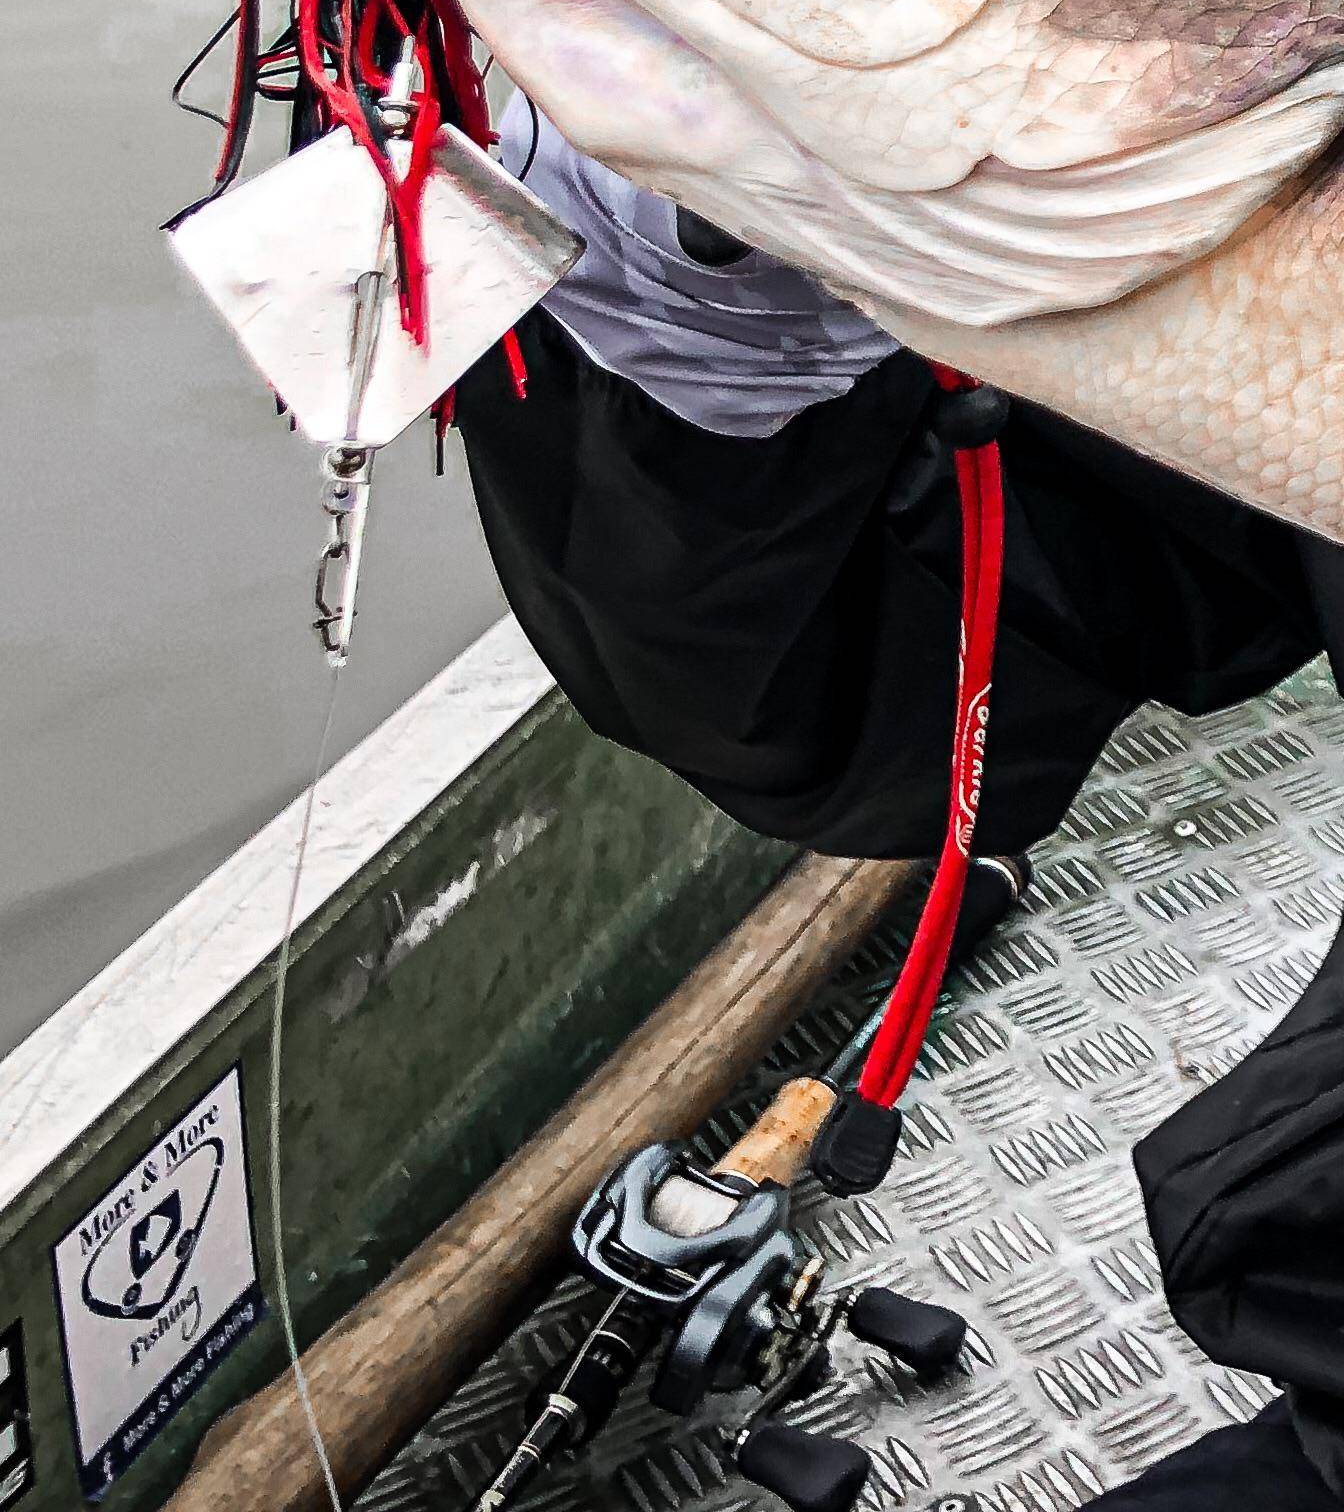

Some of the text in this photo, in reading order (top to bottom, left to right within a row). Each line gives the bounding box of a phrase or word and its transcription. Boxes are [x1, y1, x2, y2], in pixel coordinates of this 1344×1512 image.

[79, 1104, 220, 1256] More & More
[130, 1286, 201, 1367] Fishing
